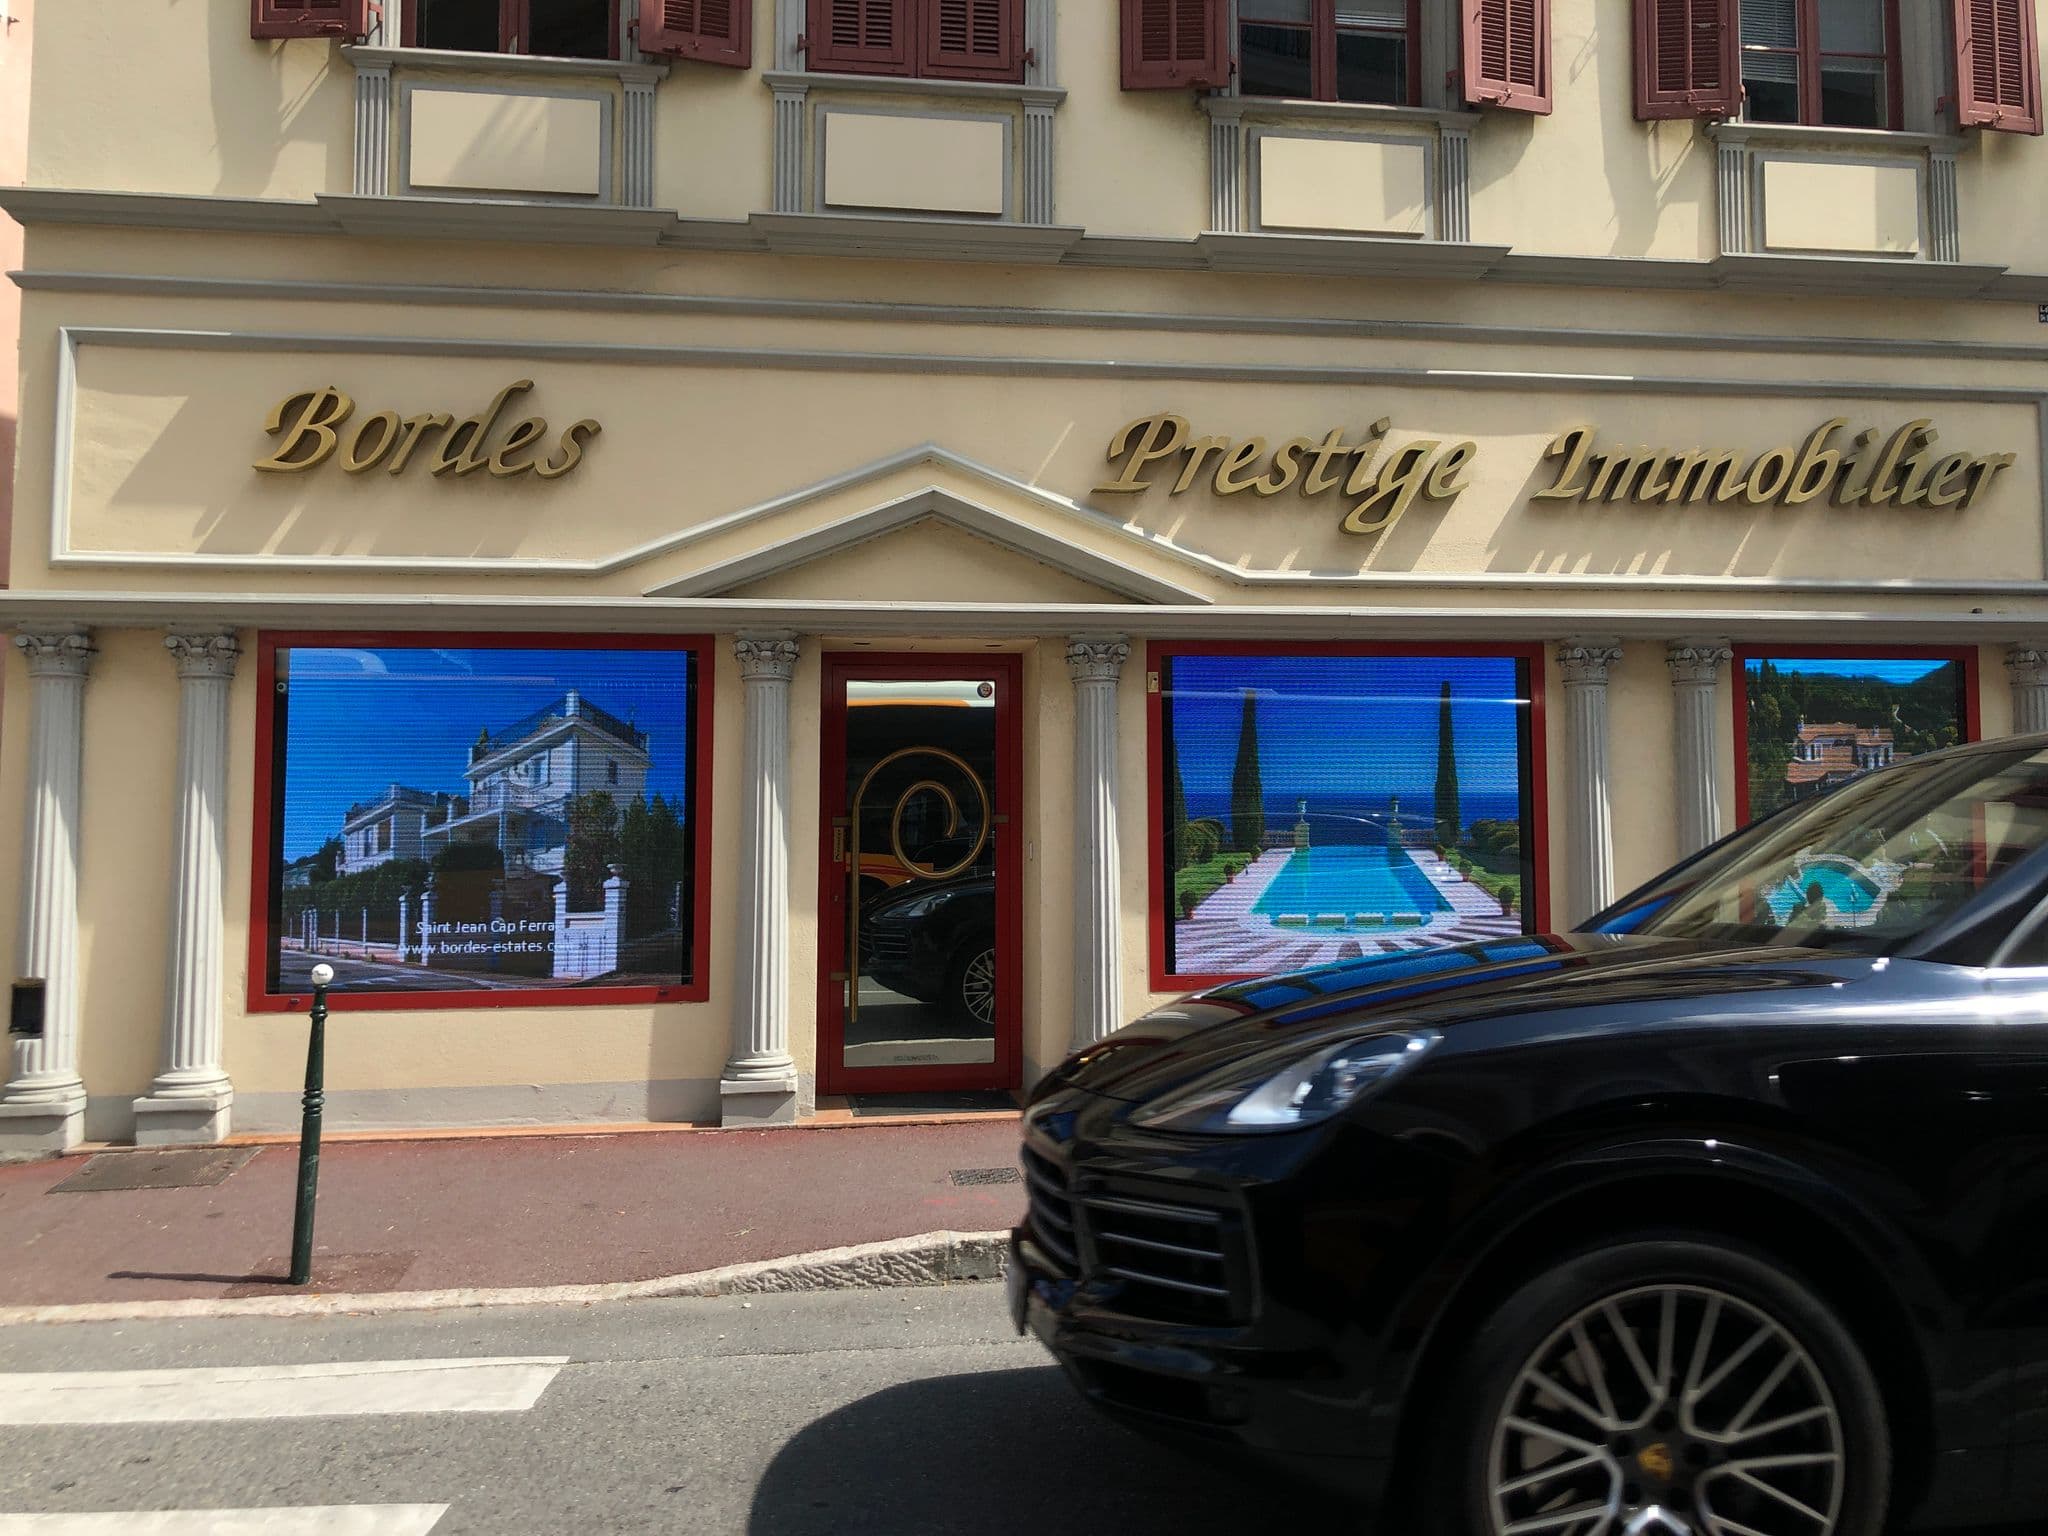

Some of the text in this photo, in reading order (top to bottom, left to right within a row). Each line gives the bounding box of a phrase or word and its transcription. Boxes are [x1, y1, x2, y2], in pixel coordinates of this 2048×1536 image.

[252, 378, 2017, 536] Bordes Prestige Immobilier
[416, 919, 561, 935] Saint Jean Cap Ferra
[398, 939, 580, 955] www.bordes-estates.c
